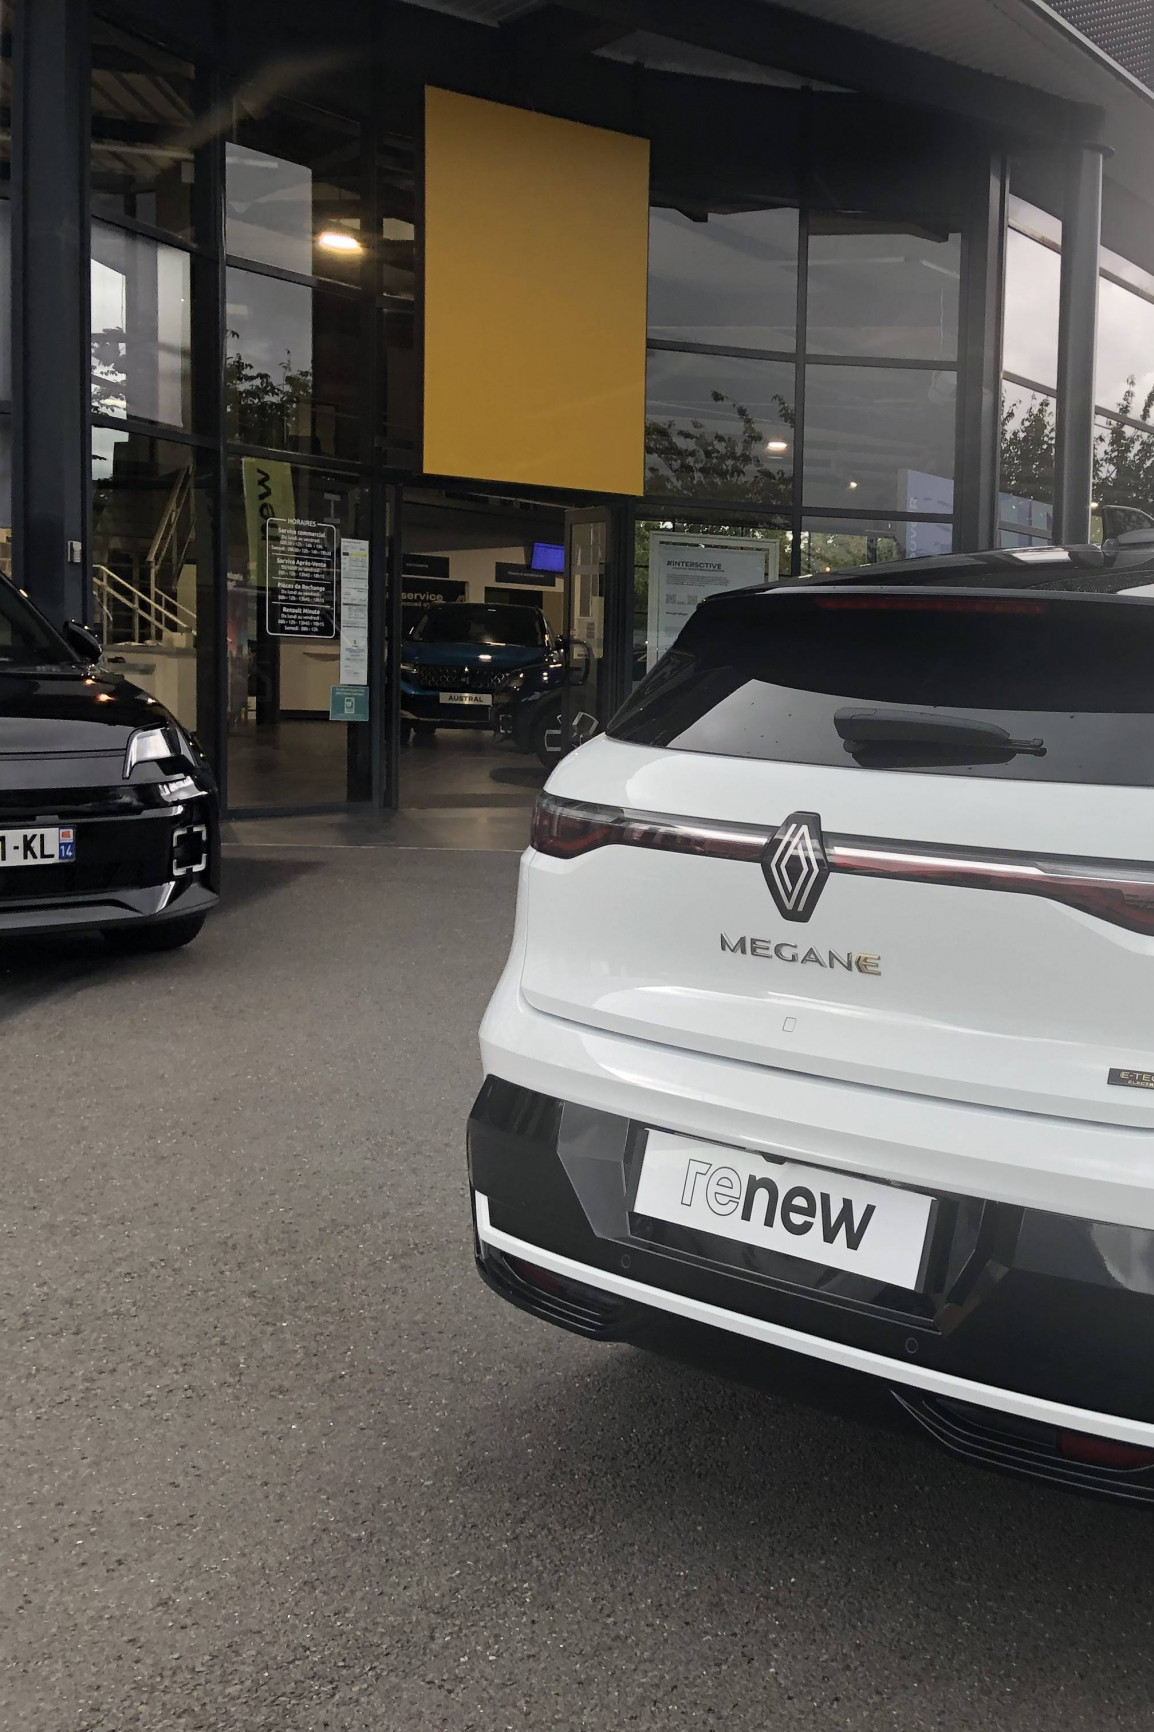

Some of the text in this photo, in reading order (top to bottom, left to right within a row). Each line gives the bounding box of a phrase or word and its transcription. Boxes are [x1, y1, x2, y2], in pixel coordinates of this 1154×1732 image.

[287, 517, 317, 527] HORAIRES
[401, 591, 443, 601] service
[448, 695, 483, 703] AUSTRAL
[60, 844, 73, 857] 14
[720, 932, 882, 976] MEGANE
[680, 1158, 877, 1251] renew
